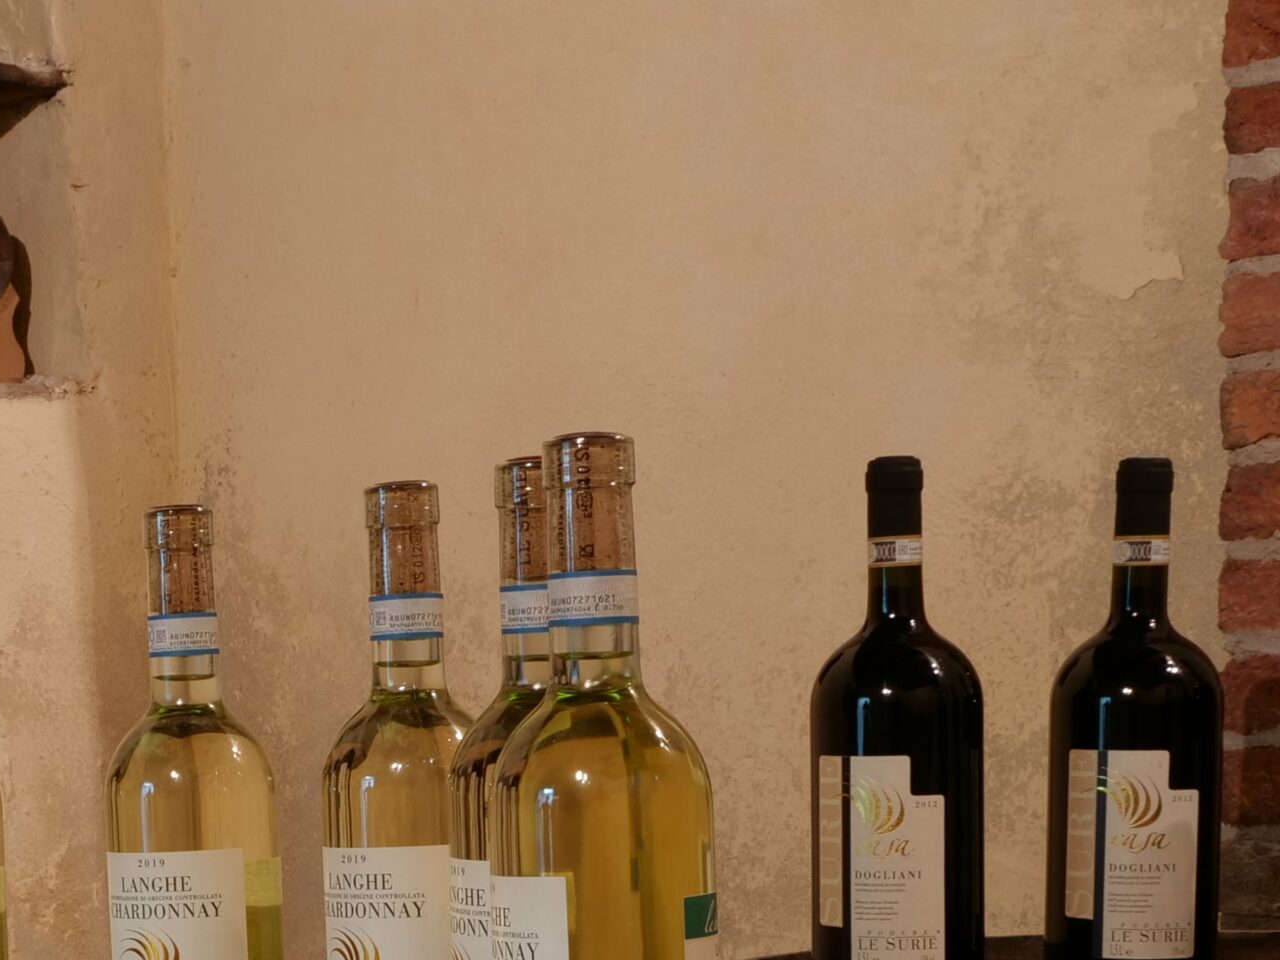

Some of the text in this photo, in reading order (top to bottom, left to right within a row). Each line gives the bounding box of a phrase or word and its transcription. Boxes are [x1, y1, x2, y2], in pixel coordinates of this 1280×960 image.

[914, 801, 938, 809] 2012
[137, 858, 166, 868] 2019
[341, 854, 367, 864] 2019
[1109, 863, 1177, 873] DOGLIANI
[855, 870, 923, 880] DOGLIANI
[121, 875, 192, 893] LANGHE
[328, 873, 393, 891] LANGHE
[174, 893, 223, 901] CONTROLLATA
[450, 886, 486, 908] NGHE
[1110, 931, 1133, 943] LE
[858, 936, 939, 951] LE SURIE
